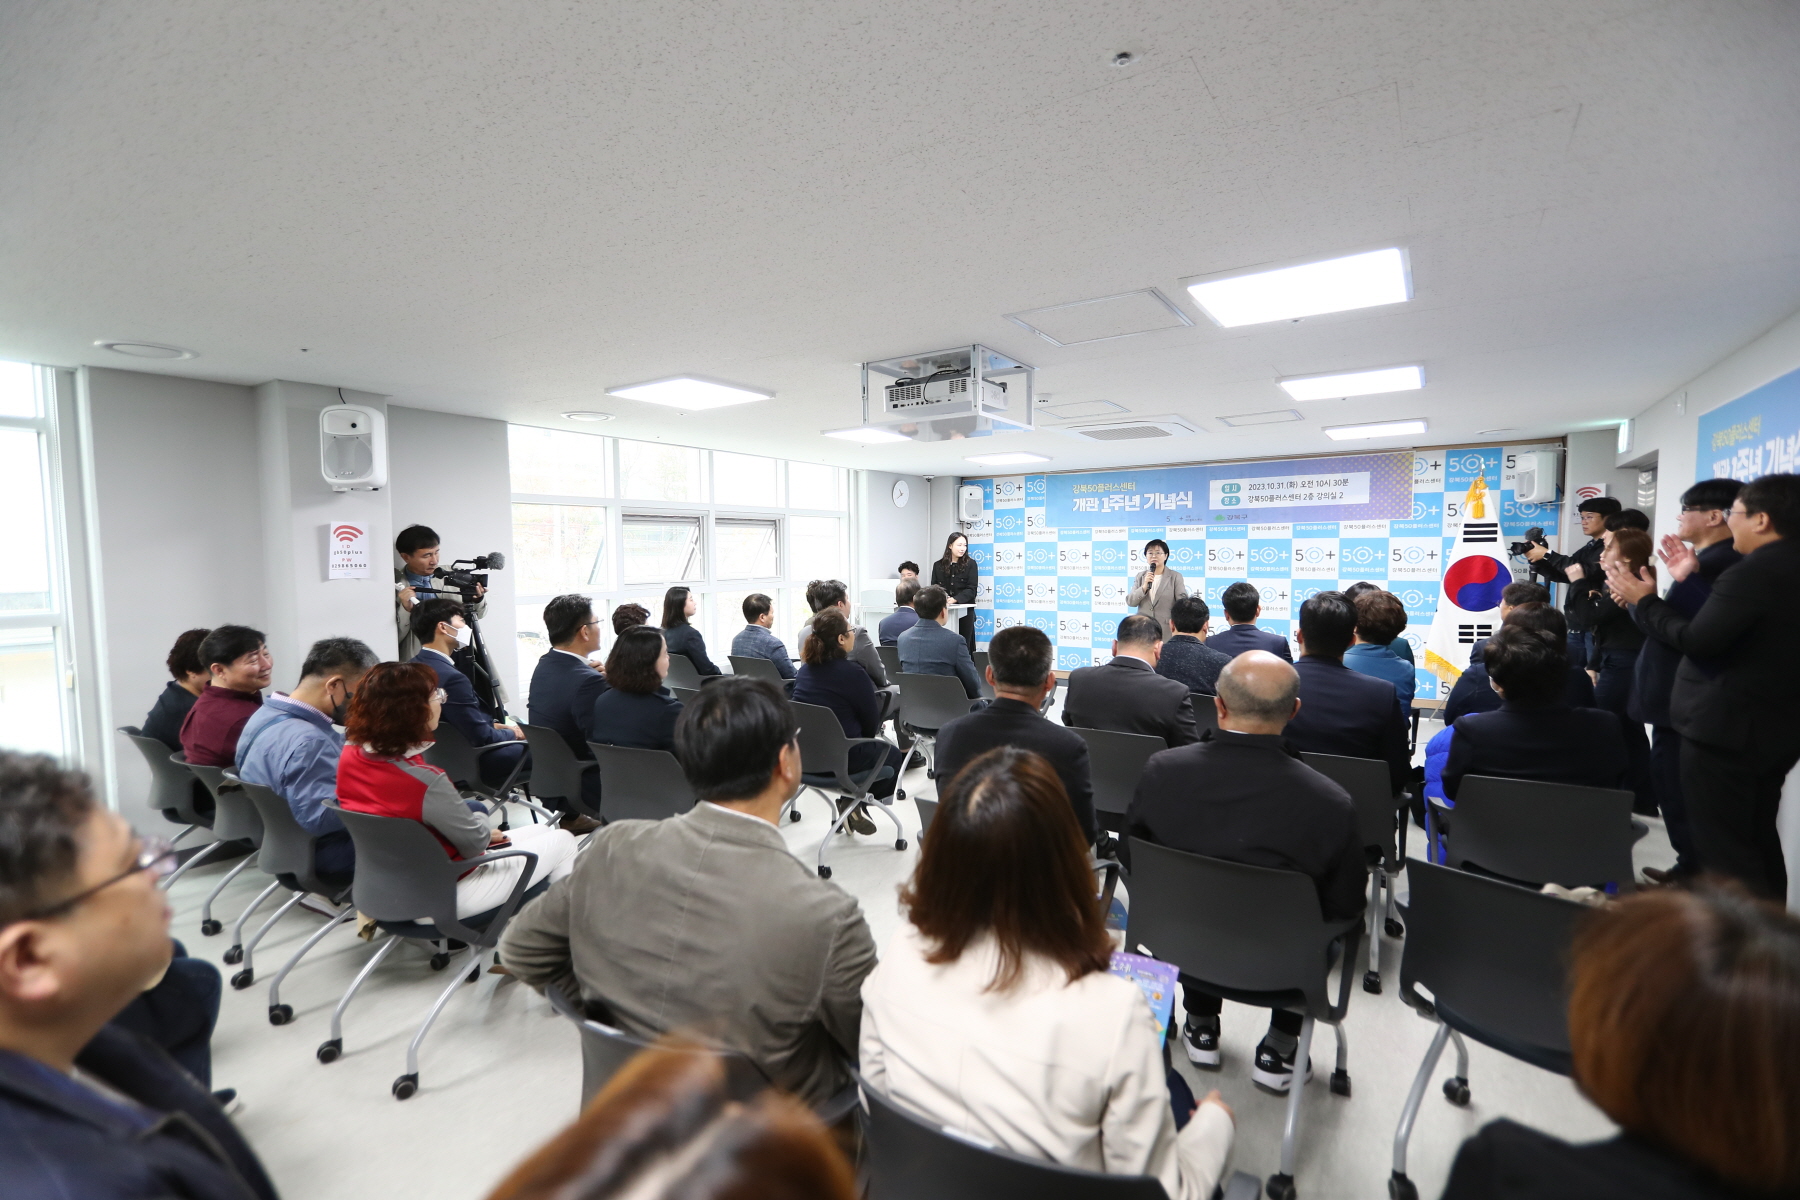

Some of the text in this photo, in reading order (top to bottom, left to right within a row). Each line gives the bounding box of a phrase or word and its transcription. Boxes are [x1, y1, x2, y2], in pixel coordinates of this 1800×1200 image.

[1072, 482, 1136, 494] 강북50플러스센터
[1300, 480, 1314, 488] 오전
[1316, 479, 1331, 488] 10시
[1333, 478, 1349, 487] 30분
[1072, 491, 1193, 513] 개관 1주년 기념식
[1247, 494, 1302, 504] 강북50플러스센터
[1303, 493, 1315, 501] 2층
[1316, 492, 1337, 500] 강의실
